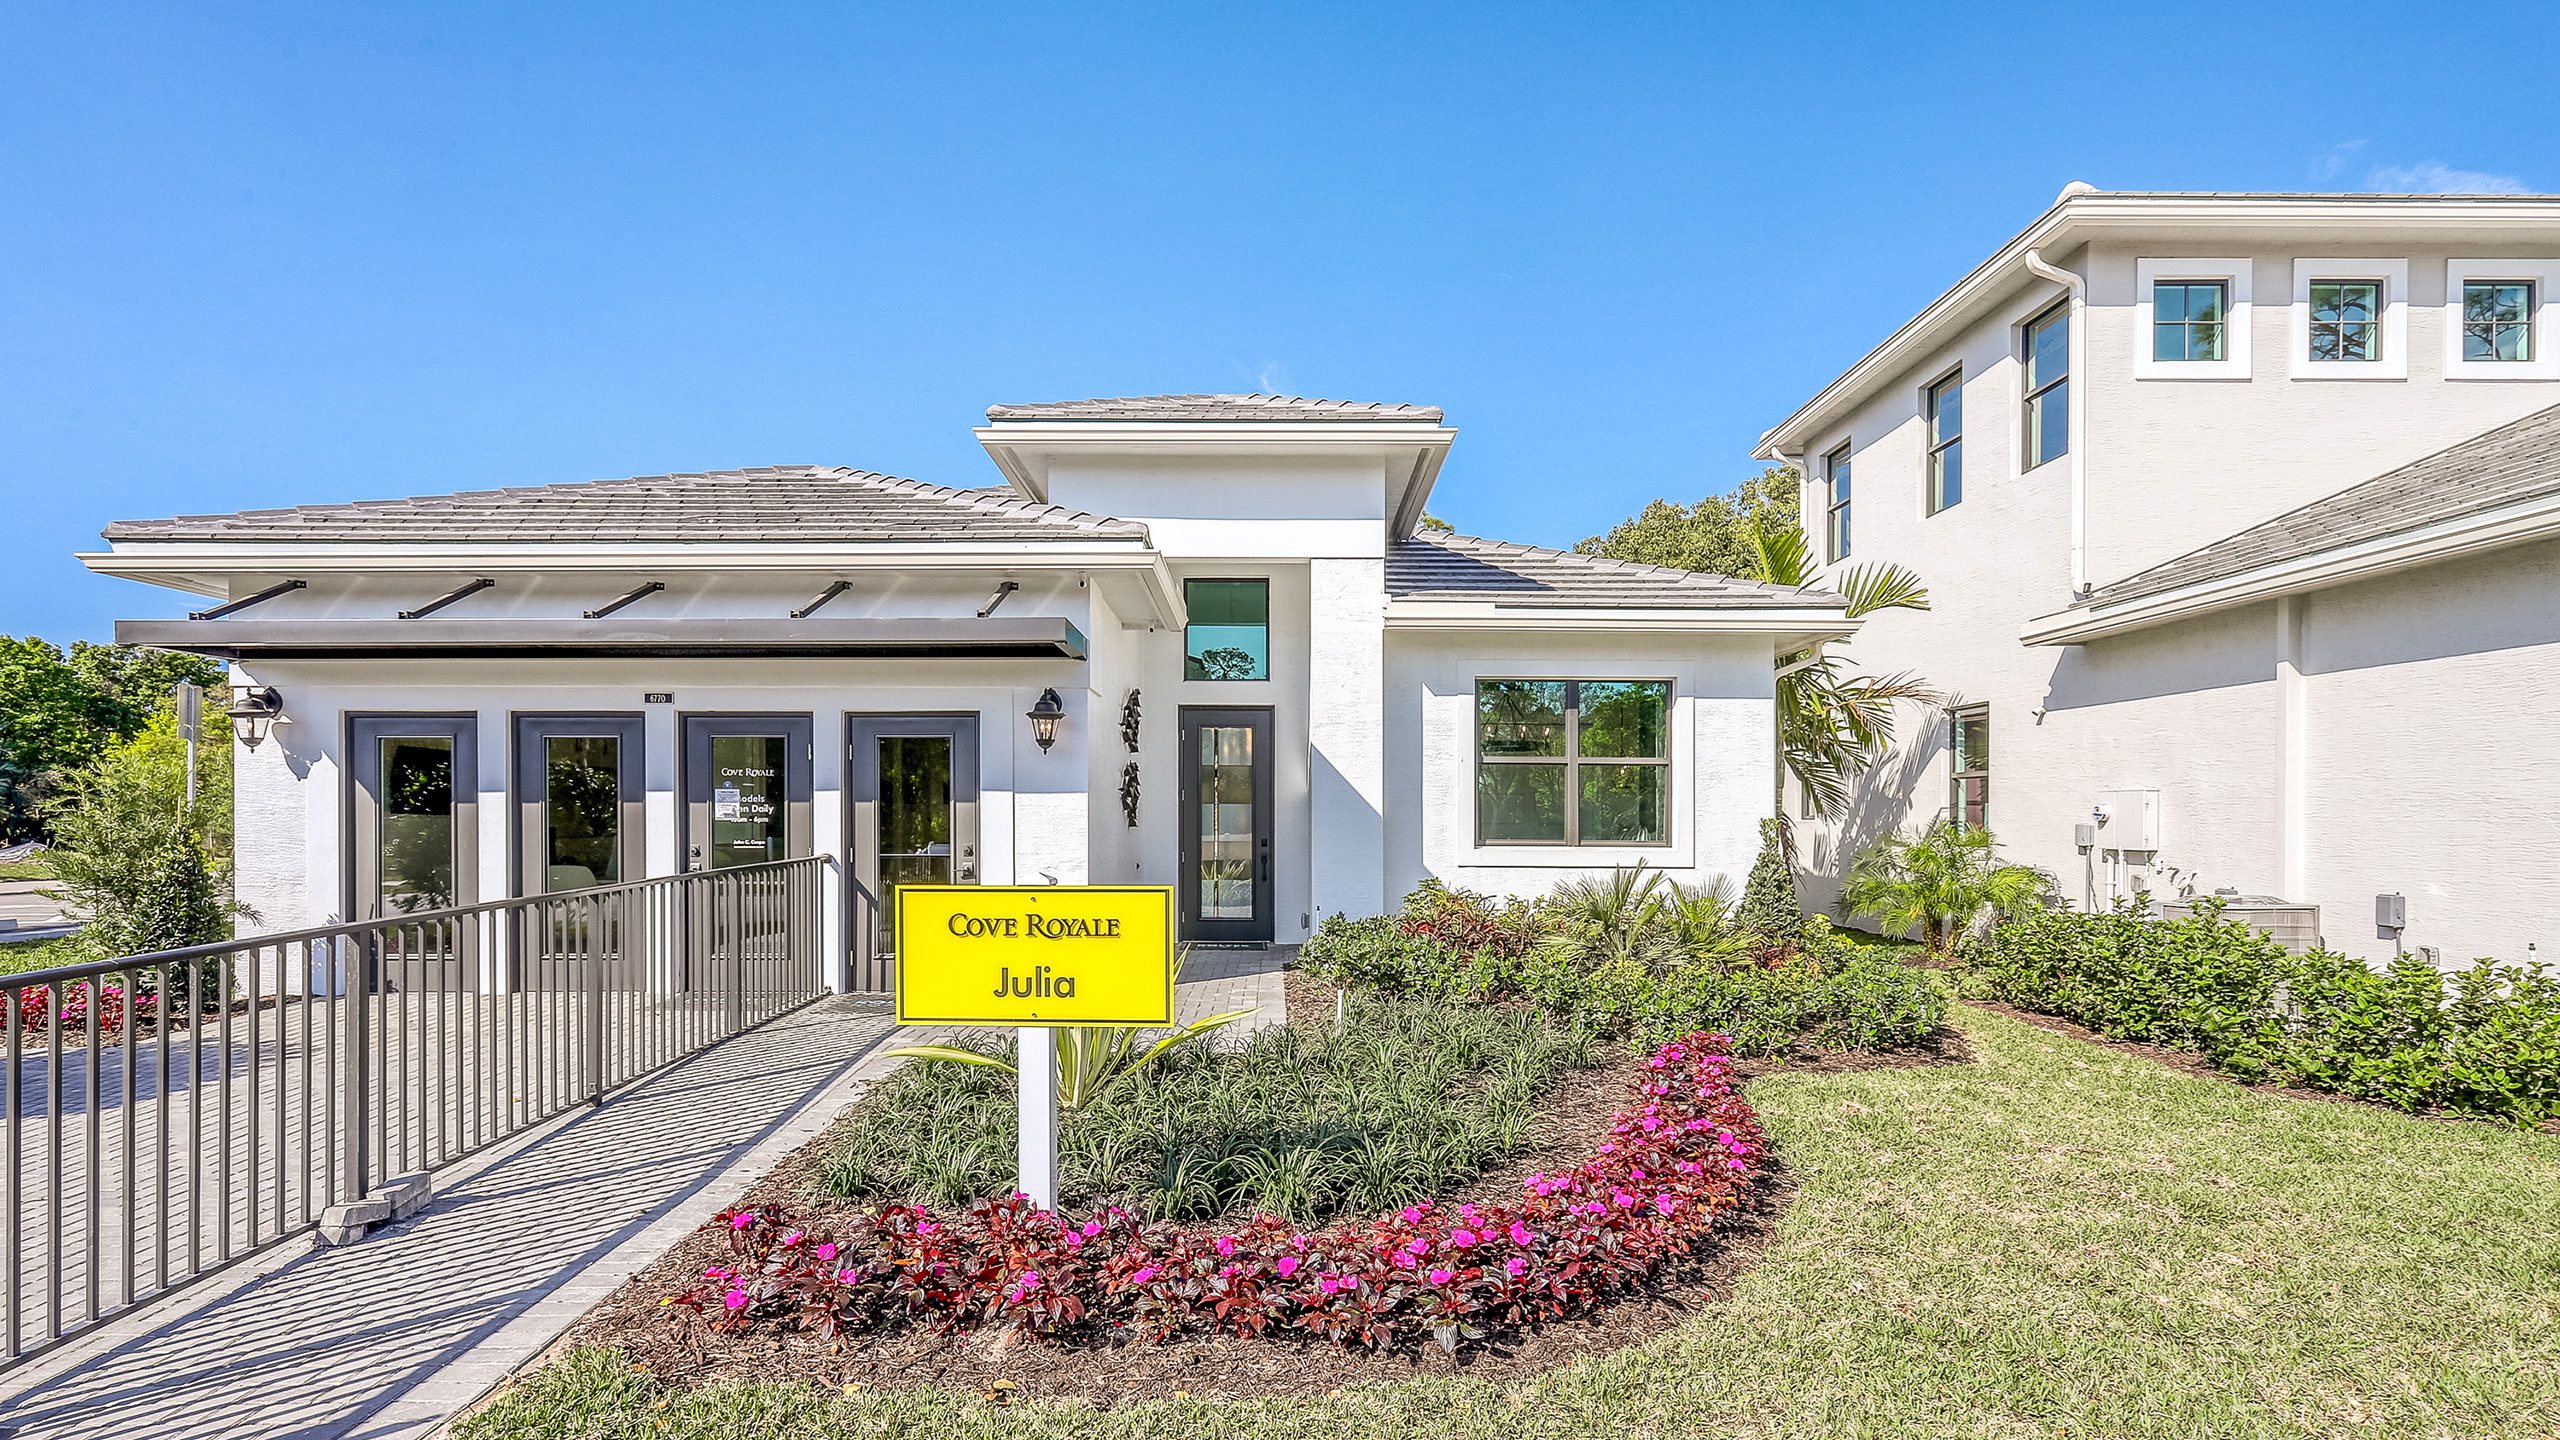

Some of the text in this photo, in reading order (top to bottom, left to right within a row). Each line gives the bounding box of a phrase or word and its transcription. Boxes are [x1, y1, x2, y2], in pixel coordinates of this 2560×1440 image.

[721, 767, 775, 777] COVE ROYALE
[740, 794, 765, 802] odels
[751, 804, 774, 815] Daily
[948, 913, 1121, 940] COVE ROYALE
[993, 966, 1076, 998] Julia
